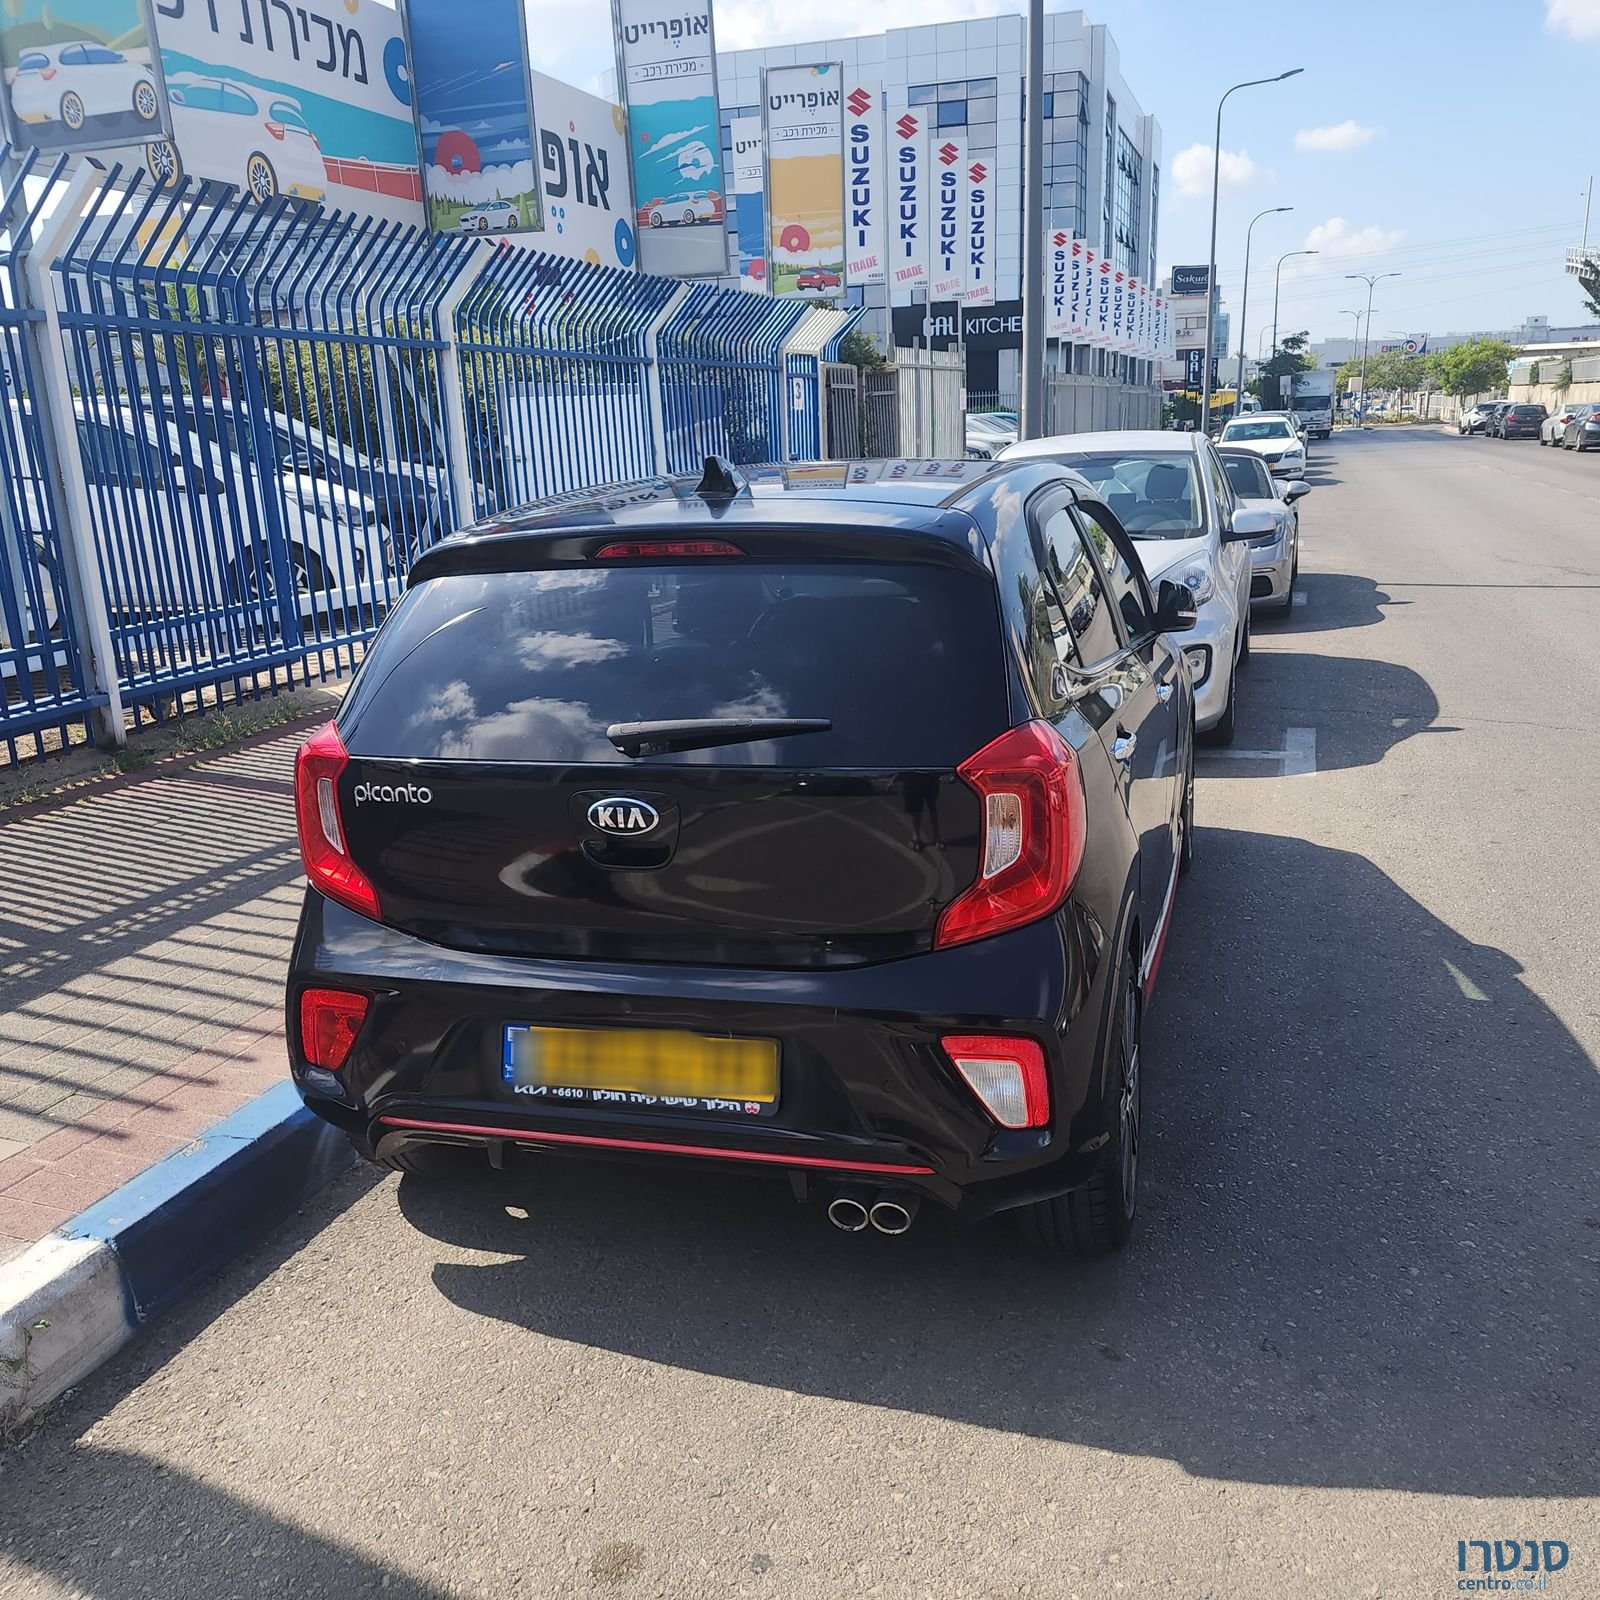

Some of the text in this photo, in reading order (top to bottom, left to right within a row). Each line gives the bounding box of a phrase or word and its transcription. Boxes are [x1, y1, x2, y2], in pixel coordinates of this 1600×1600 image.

[625, 13, 708, 45] אופרייט
[240, 0, 369, 85] מכירת
[642, 61, 697, 78] מכירת רכב
[770, 89, 839, 111] אופרייט
[783, 125, 828, 138] מכירת רכב
[736, 139, 762, 154] ייט
[851, 124, 871, 247] SUZUKI
[899, 146, 917, 257] SUZUKI
[940, 171, 957, 271] SUZUKI
[970, 189, 985, 280] SUZUKI
[847, 255, 879, 275] TRADE
[894, 264, 924, 282] TRADE
[934, 278, 961, 294] TRADE
[966, 286, 990, 300] TRADE
[1054, 250, 1065, 317] SUZUKI
[1099, 276, 1109, 332] SUZUKI
[1113, 286, 1123, 337] SUZUKI
[1126, 292, 1136, 339] SUZUKI
[966, 316, 1025, 335] KITCHE
[1189, 350, 1199, 383] GAL
[353, 782, 433, 808] picanto
[596, 806, 649, 830] KIA
[592, 1089, 627, 1102] חולון
[701, 1098, 741, 1112] הילוך
